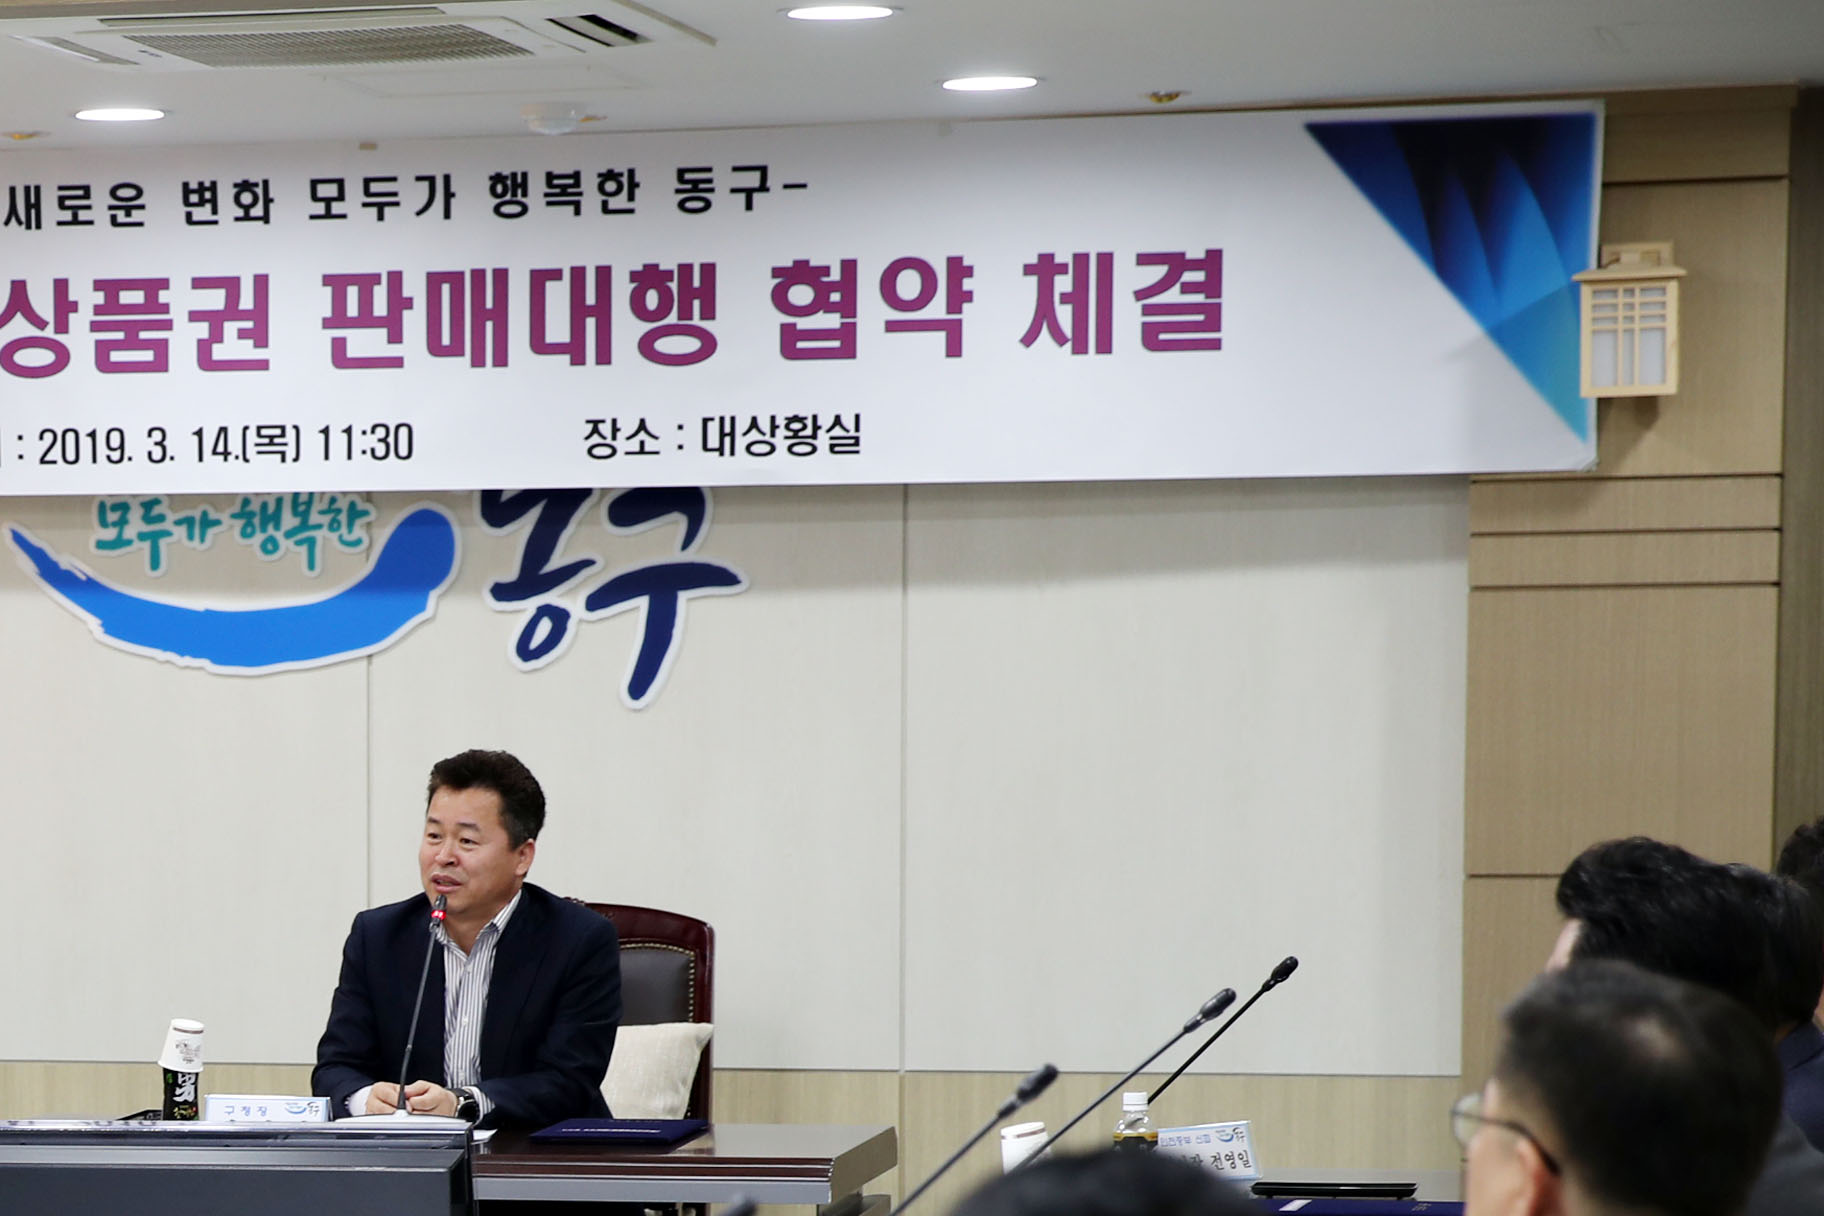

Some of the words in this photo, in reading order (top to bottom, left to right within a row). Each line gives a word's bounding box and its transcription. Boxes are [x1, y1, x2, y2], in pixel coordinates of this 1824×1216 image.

[181, 178, 275, 227] 변화
[308, 172, 457, 222] 모두가
[487, 167, 642, 220] 행복한
[321, 262, 719, 370] 판매대행
[770, 256, 974, 361] 협약
[1019, 248, 1224, 355] 체결
[38, 427, 133, 465] 2019.
[147, 427, 175, 464] 3.
[318, 422, 414, 461] 11:30
[583, 417, 661, 460] 장소
[701, 413, 861, 458] 대상황실
[95, 497, 223, 572] 모두가
[229, 492, 370, 572] 행복한
[1210, 1149, 1253, 1171] 전영일
